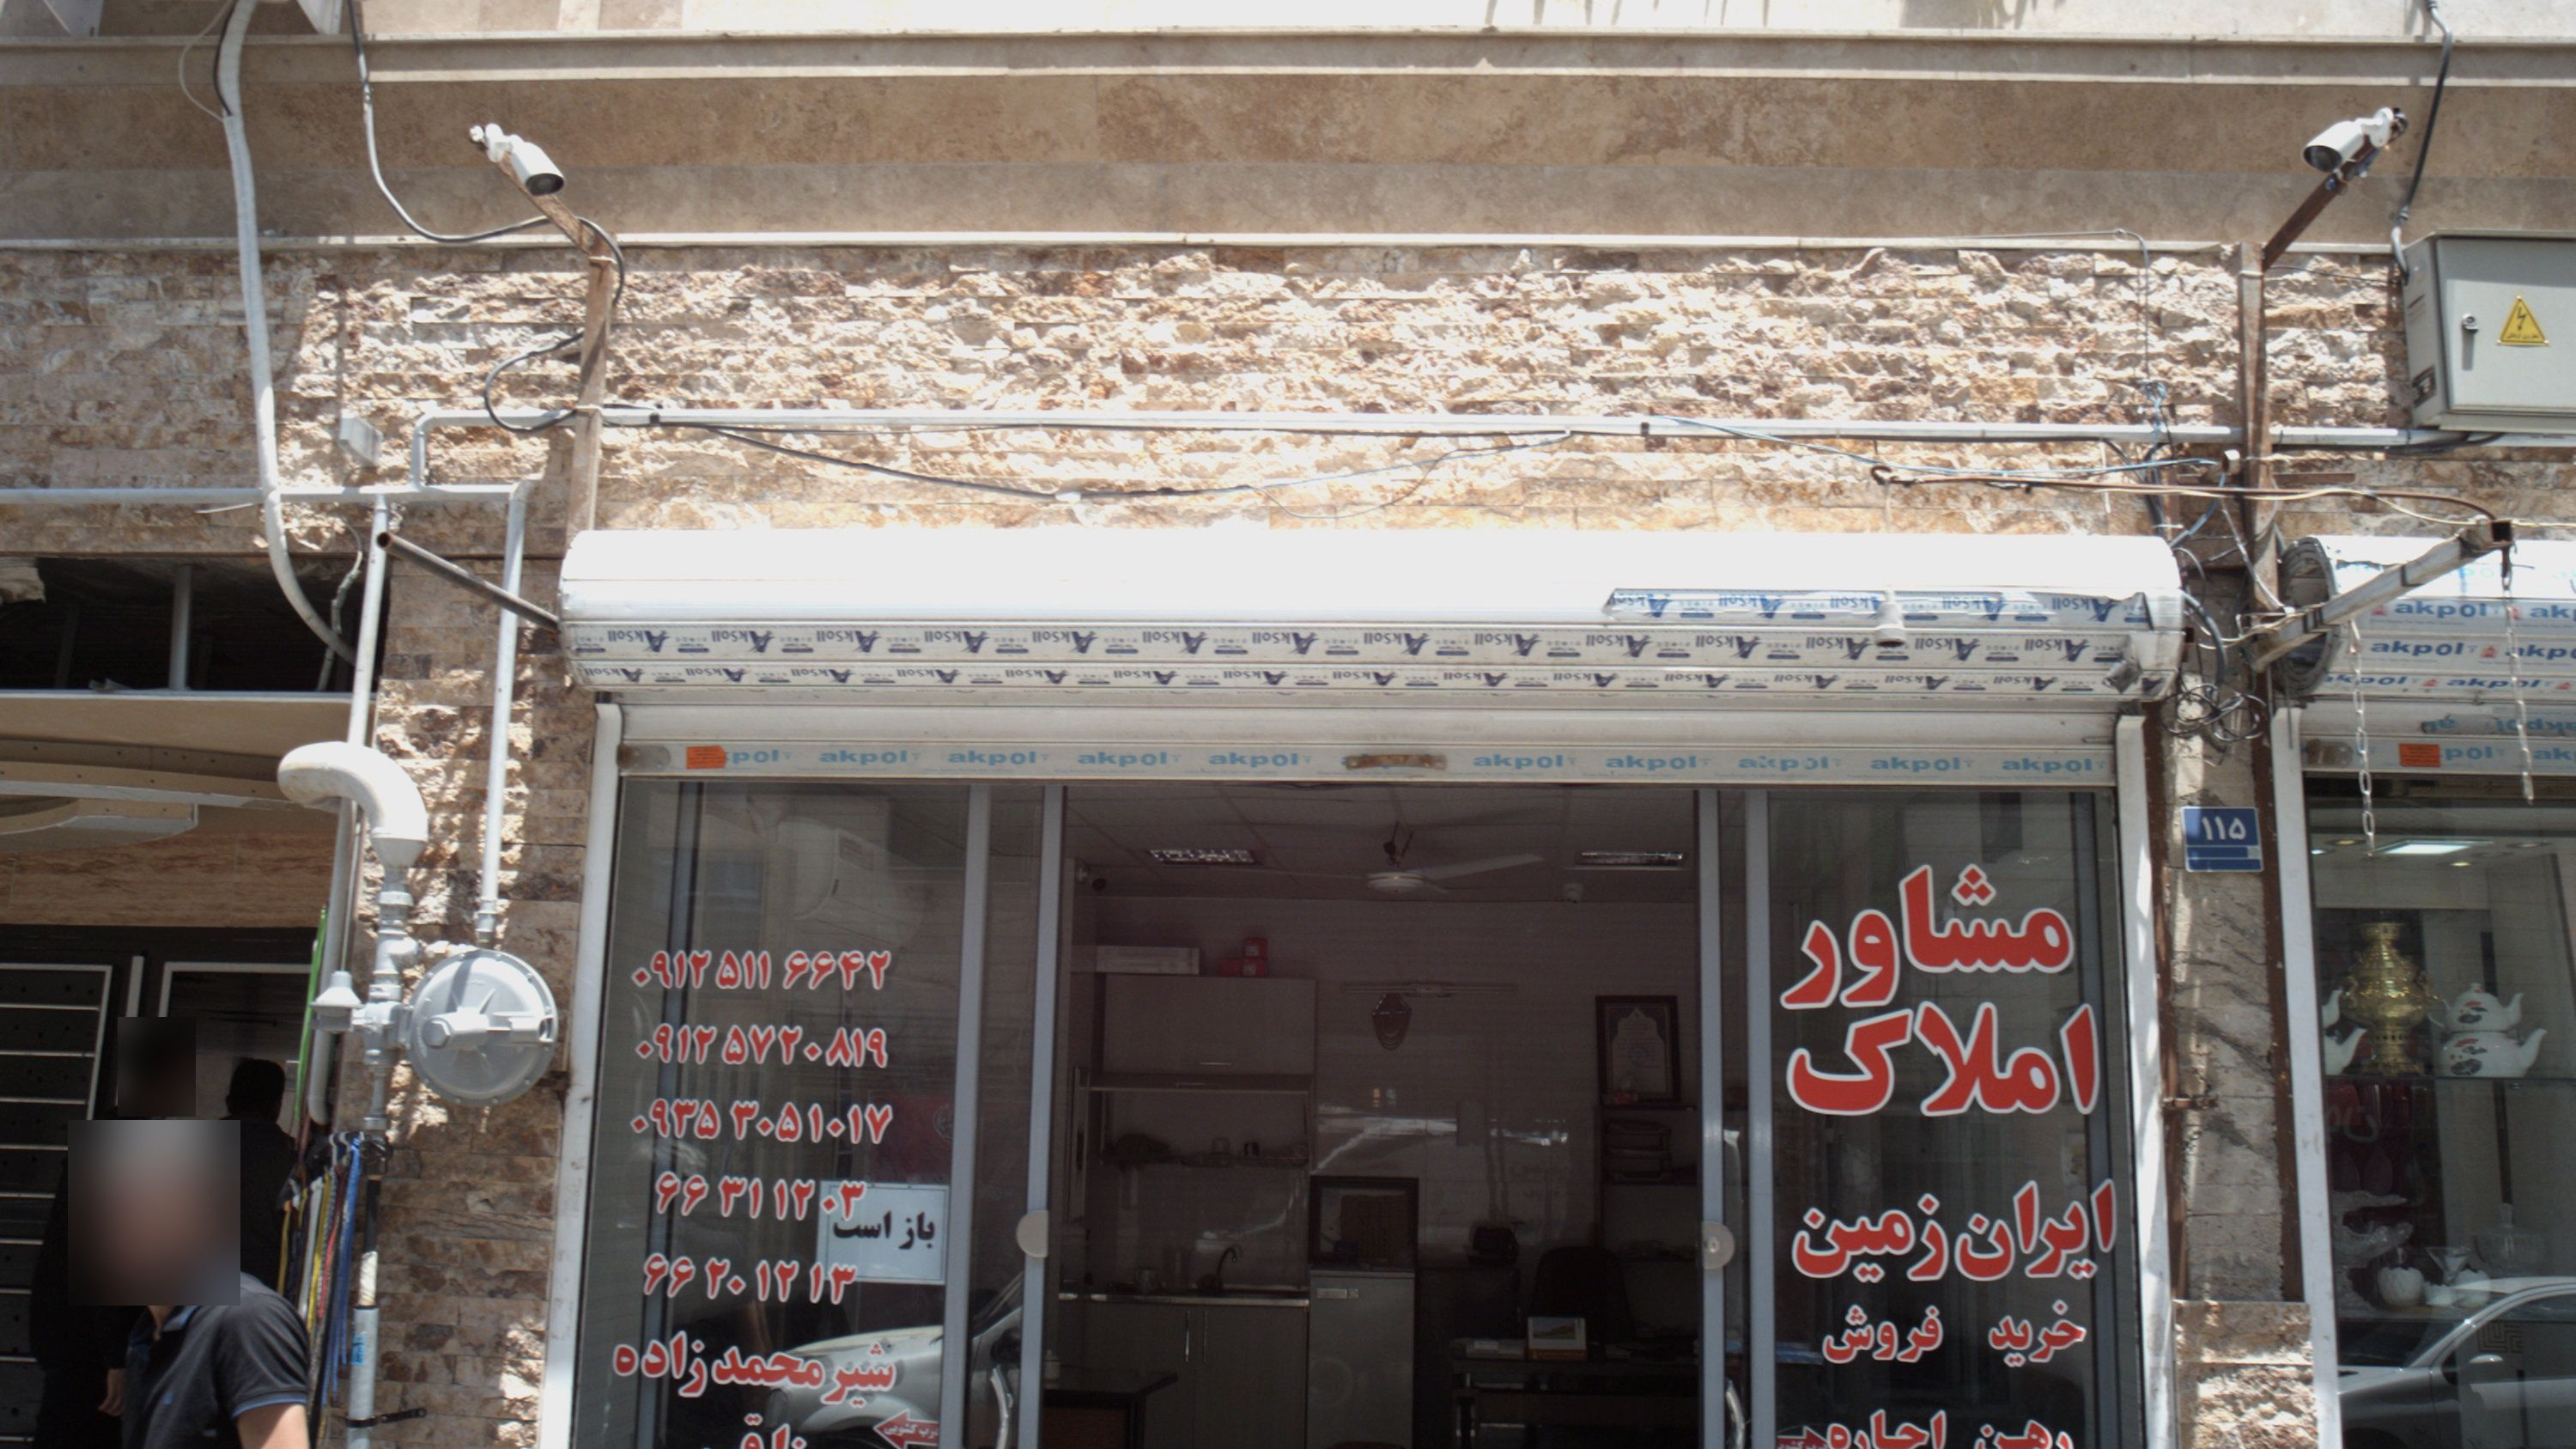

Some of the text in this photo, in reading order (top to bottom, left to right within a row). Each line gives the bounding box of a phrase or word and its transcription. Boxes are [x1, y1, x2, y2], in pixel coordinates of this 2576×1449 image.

[2202, 816, 2246, 840] ۱۱۵
[1780, 863, 2075, 1009] مشاور
[1786, 1001, 2100, 1117] املاک
[833, 1210, 935, 1250] باز است
[1791, 1178, 2117, 1283] ایران زمین
[1822, 1299, 2087, 1367] خرید فروش
